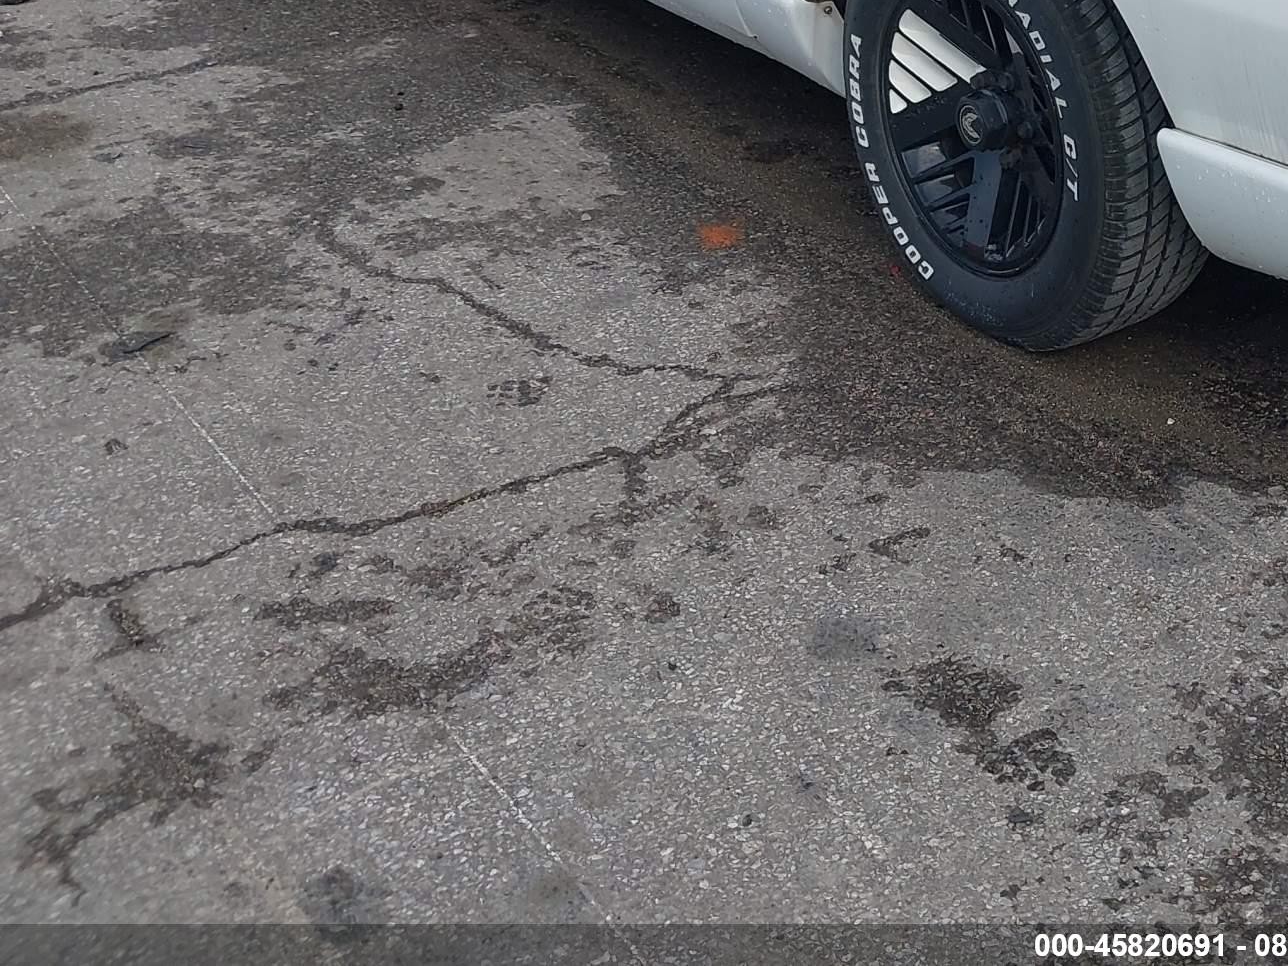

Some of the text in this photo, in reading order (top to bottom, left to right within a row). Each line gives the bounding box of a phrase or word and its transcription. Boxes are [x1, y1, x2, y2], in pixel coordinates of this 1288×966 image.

[846, 34, 935, 281] COOPER COBRA
[1063, 133, 1080, 202] G/T
